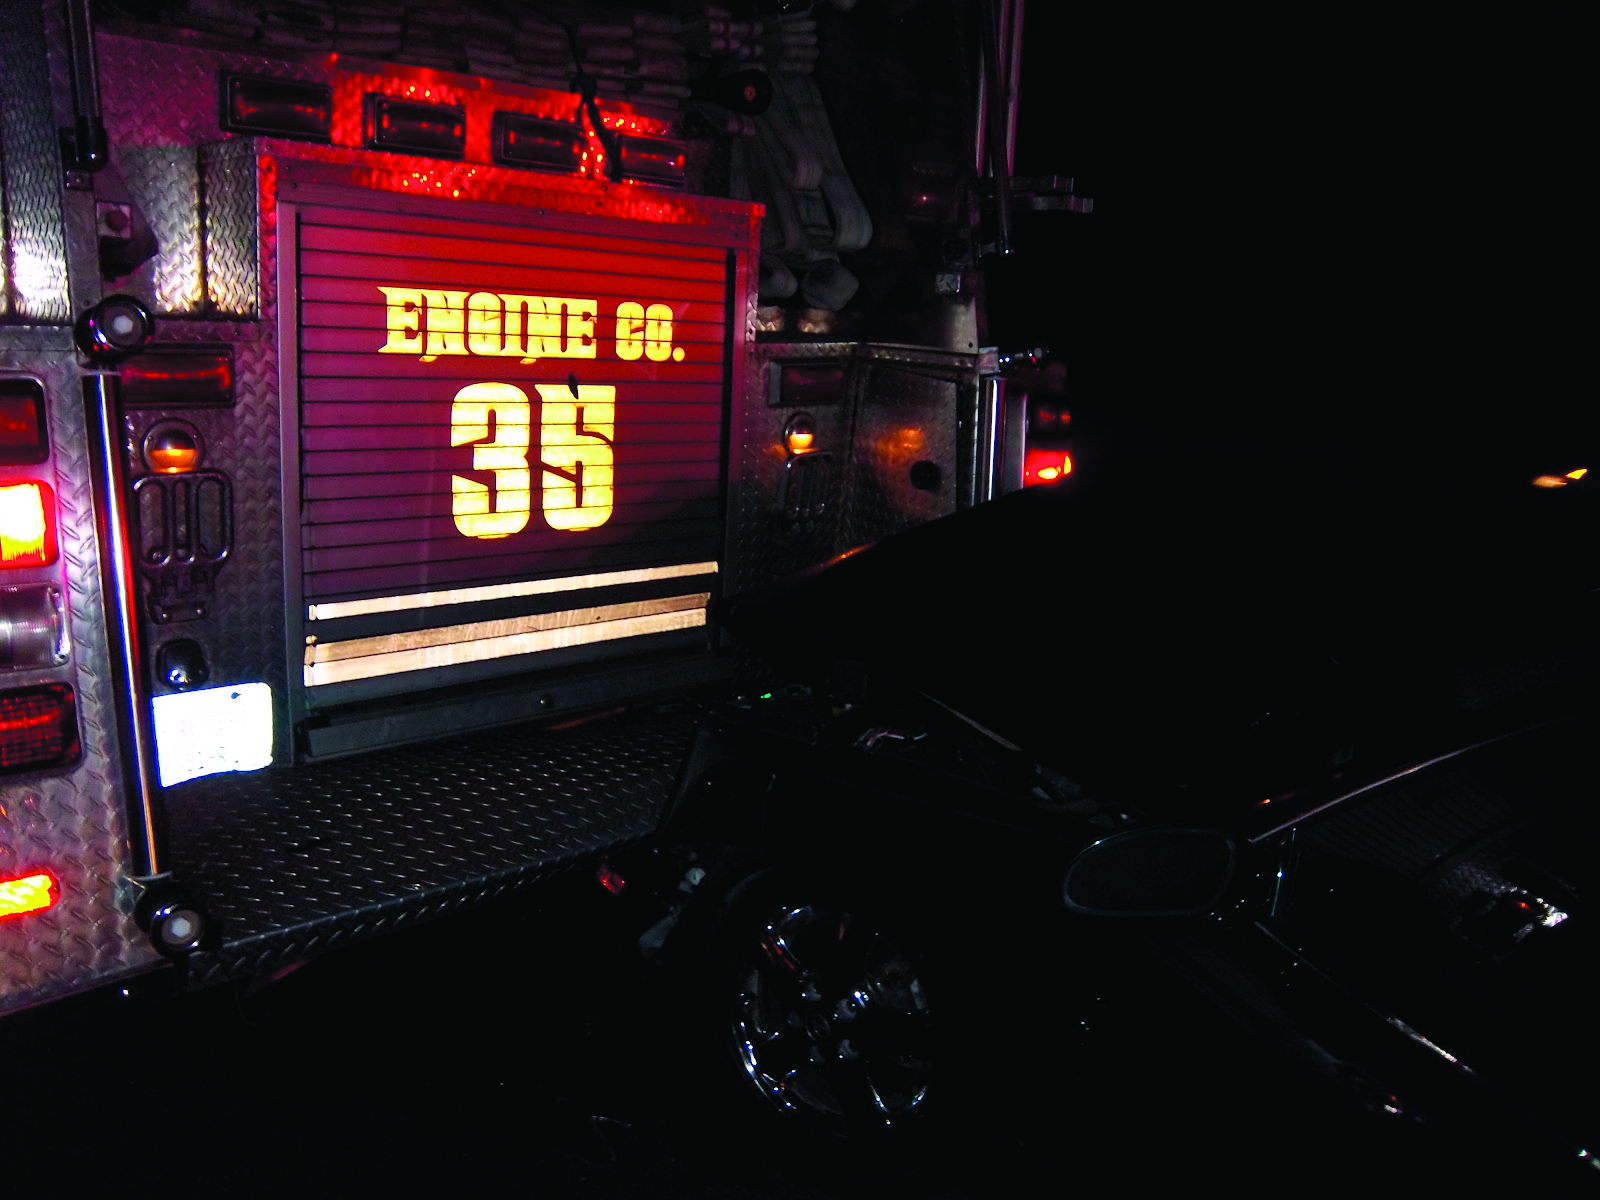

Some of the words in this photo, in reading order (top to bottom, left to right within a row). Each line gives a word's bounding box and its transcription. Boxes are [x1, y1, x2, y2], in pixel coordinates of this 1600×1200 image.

[377, 286, 598, 364] ENGINE
[615, 301, 686, 362] CO.
[450, 381, 616, 539] 35
